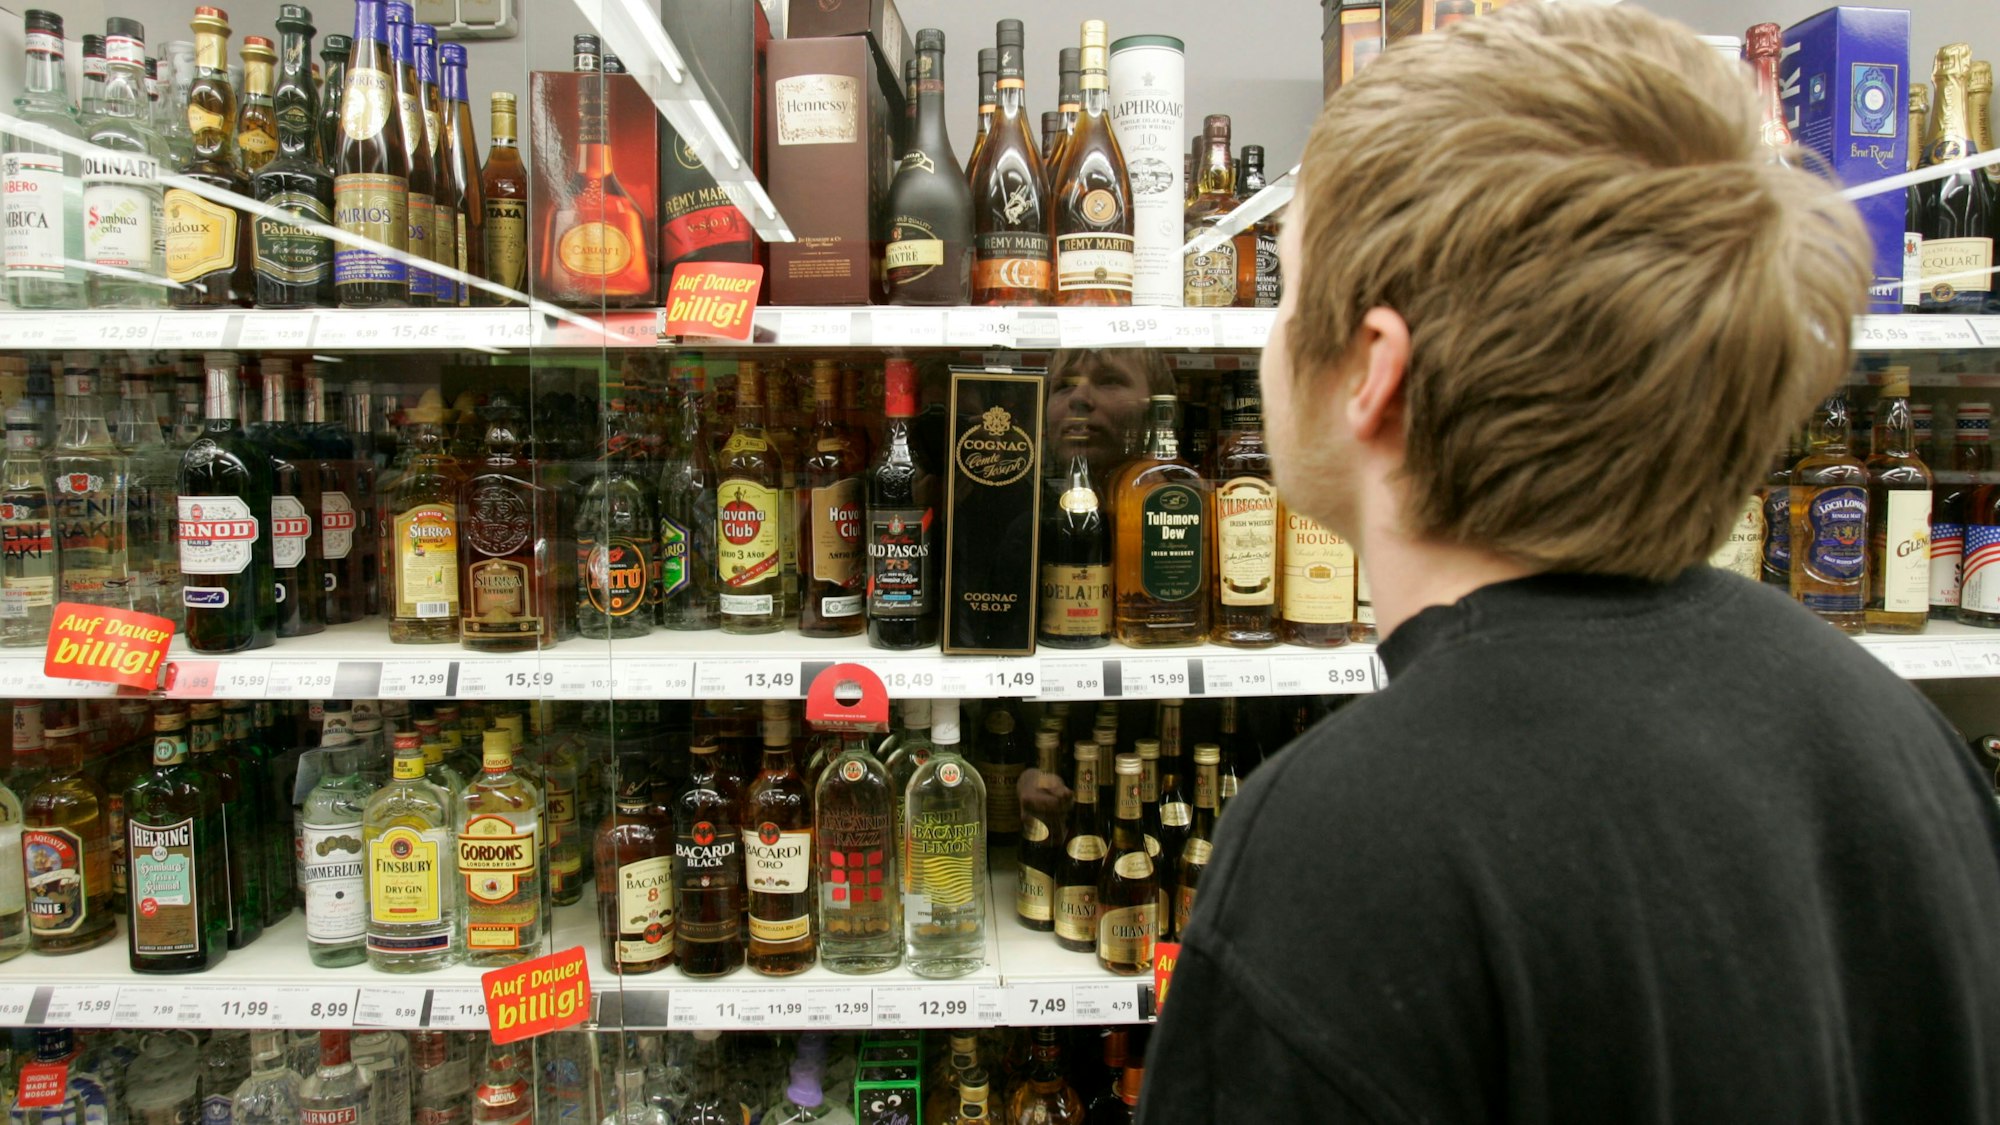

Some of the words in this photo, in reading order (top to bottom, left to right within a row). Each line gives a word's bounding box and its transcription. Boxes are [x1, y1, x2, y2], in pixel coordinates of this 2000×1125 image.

[786, 97, 849, 115] Hennessy
[1138, 133, 1157, 146] 10
[1850, 143, 1869, 159] Brut
[1870, 142, 1895, 169] Royal
[82, 157, 157, 179] OLINARI
[665, 189, 697, 215] RÉMY
[5, 211, 49, 229] MBUCA
[88, 204, 137, 228] Sambuca
[336, 207, 392, 225] MIRIOS
[486, 207, 522, 220] TAXA
[101, 221, 122, 234] extra
[167, 222, 210, 237] pidoux
[984, 235, 1015, 250] RÉMY
[1015, 236, 1048, 250] MARTIN
[1064, 237, 1096, 250] RÉMY
[1096, 237, 1132, 250] MARTIN
[1197, 256, 1206, 265] 12
[1921, 253, 1980, 268] CQUART
[673, 273, 704, 293] Auf
[703, 273, 757, 294] Dauer
[1256, 284, 1278, 292] SKEY
[1867, 285, 1894, 297] MERY
[667, 293, 748, 329] billig!
[99, 326, 149, 340] 12,99
[486, 324, 535, 338] 11,49
[619, 325, 656, 337] 14,99
[811, 324, 847, 335] 21,99
[1107, 318, 1158, 335] 18,99
[1175, 326, 1210, 337] 25,99
[1862, 327, 1909, 341] 26,99
[734, 439, 742, 448] 3
[963, 439, 1027, 452] COGNAC
[965, 452, 1001, 469] Comte
[980, 456, 1027, 478] Joseph
[1218, 495, 1275, 520] KILBEGGAN
[1772, 500, 1789, 511] LOC
[1819, 500, 1843, 514] LOCH
[1843, 498, 1868, 514] LOMON
[719, 507, 766, 522] Havana
[1146, 511, 1199, 526] Tullamore
[179, 521, 252, 538] ERNOD
[409, 523, 451, 538] SIERRA
[724, 522, 753, 538] Club
[1229, 519, 1247, 527] IRISH
[1248, 519, 1274, 527] WHISKEY
[1161, 526, 1186, 540] Dew
[1296, 533, 1345, 545] HOUSE
[187, 539, 210, 547] PARIS
[664, 542, 685, 558] ARIO
[868, 543, 886, 557] OLD
[886, 543, 928, 558] PASCAS
[1896, 538, 1929, 558] GLEN
[4, 544, 42, 560] AKI
[737, 550, 744, 560] 3
[746, 549, 766, 559] AÑOS
[885, 559, 910, 571] 73
[474, 573, 522, 587] SIERRA
[963, 592, 1018, 603] COGNAC
[1044, 582, 1110, 600] DELAITR
[969, 602, 1012, 612] V.S.O.P
[59, 613, 105, 635] Auf
[104, 618, 170, 645] Dauer
[53, 636, 161, 675] billig!
[230, 675, 264, 687] 15,99
[296, 675, 331, 687] 12,99
[410, 674, 445, 686] 12,99
[505, 672, 554, 688] 15,99
[590, 679, 618, 688] 10,79
[665, 680, 687, 689] 9,99
[745, 673, 794, 688] 13,49
[884, 673, 933, 688] 18,49
[985, 672, 1035, 687] 11,49
[1076, 680, 1098, 689] 8,99
[1150, 674, 1185, 686] 15,99
[1239, 675, 1265, 685] 12,99
[1328, 669, 1366, 685] 8,99
[133, 825, 189, 848] HELBING
[912, 821, 980, 840] BACARDI
[34, 834, 68, 852] AQUAVIT
[833, 832, 881, 846] RAZZ
[922, 838, 974, 854] LIMÓN
[460, 842, 524, 862] GORDON'S
[675, 842, 735, 859] BACARDI
[745, 845, 802, 861] BACARDI
[376, 858, 433, 873] FINSBURY
[687, 857, 723, 867] BLACK
[757, 860, 783, 869] ORO
[305, 862, 364, 881] OMMERLUN
[626, 870, 673, 890] BACARD
[385, 885, 403, 894] DRY
[404, 885, 423, 893] GIN
[647, 887, 659, 902] 8
[30, 903, 62, 915] LINIE
[1060, 901, 1097, 917] CHANT
[1111, 923, 1158, 938] CHANTR
[1157, 954, 1175, 973] Au
[490, 974, 526, 1000] Auf
[531, 958, 584, 990] Dauer
[77, 1000, 111, 1012] 15,99
[152, 1006, 173, 1016] 7,99
[220, 1001, 269, 1018] 11,99
[310, 1002, 348, 1019] 8,99
[395, 1008, 416, 1018] 8,99
[497, 980, 585, 1031] billig!
[767, 1004, 802, 1016] 11,99
[835, 1003, 869, 1015] 12,99
[919, 1000, 968, 1017] 12,99
[1029, 998, 1066, 1016] 7,49
[1112, 1002, 1133, 1011] 4,79
[25, 1082, 48, 1090] MADE
[49, 1081, 58, 1089] IN
[26, 1073, 59, 1083] ORIGINALLY
[24, 1088, 57, 1098] MOSCOW
[302, 1108, 355, 1125] MIRNOFF
